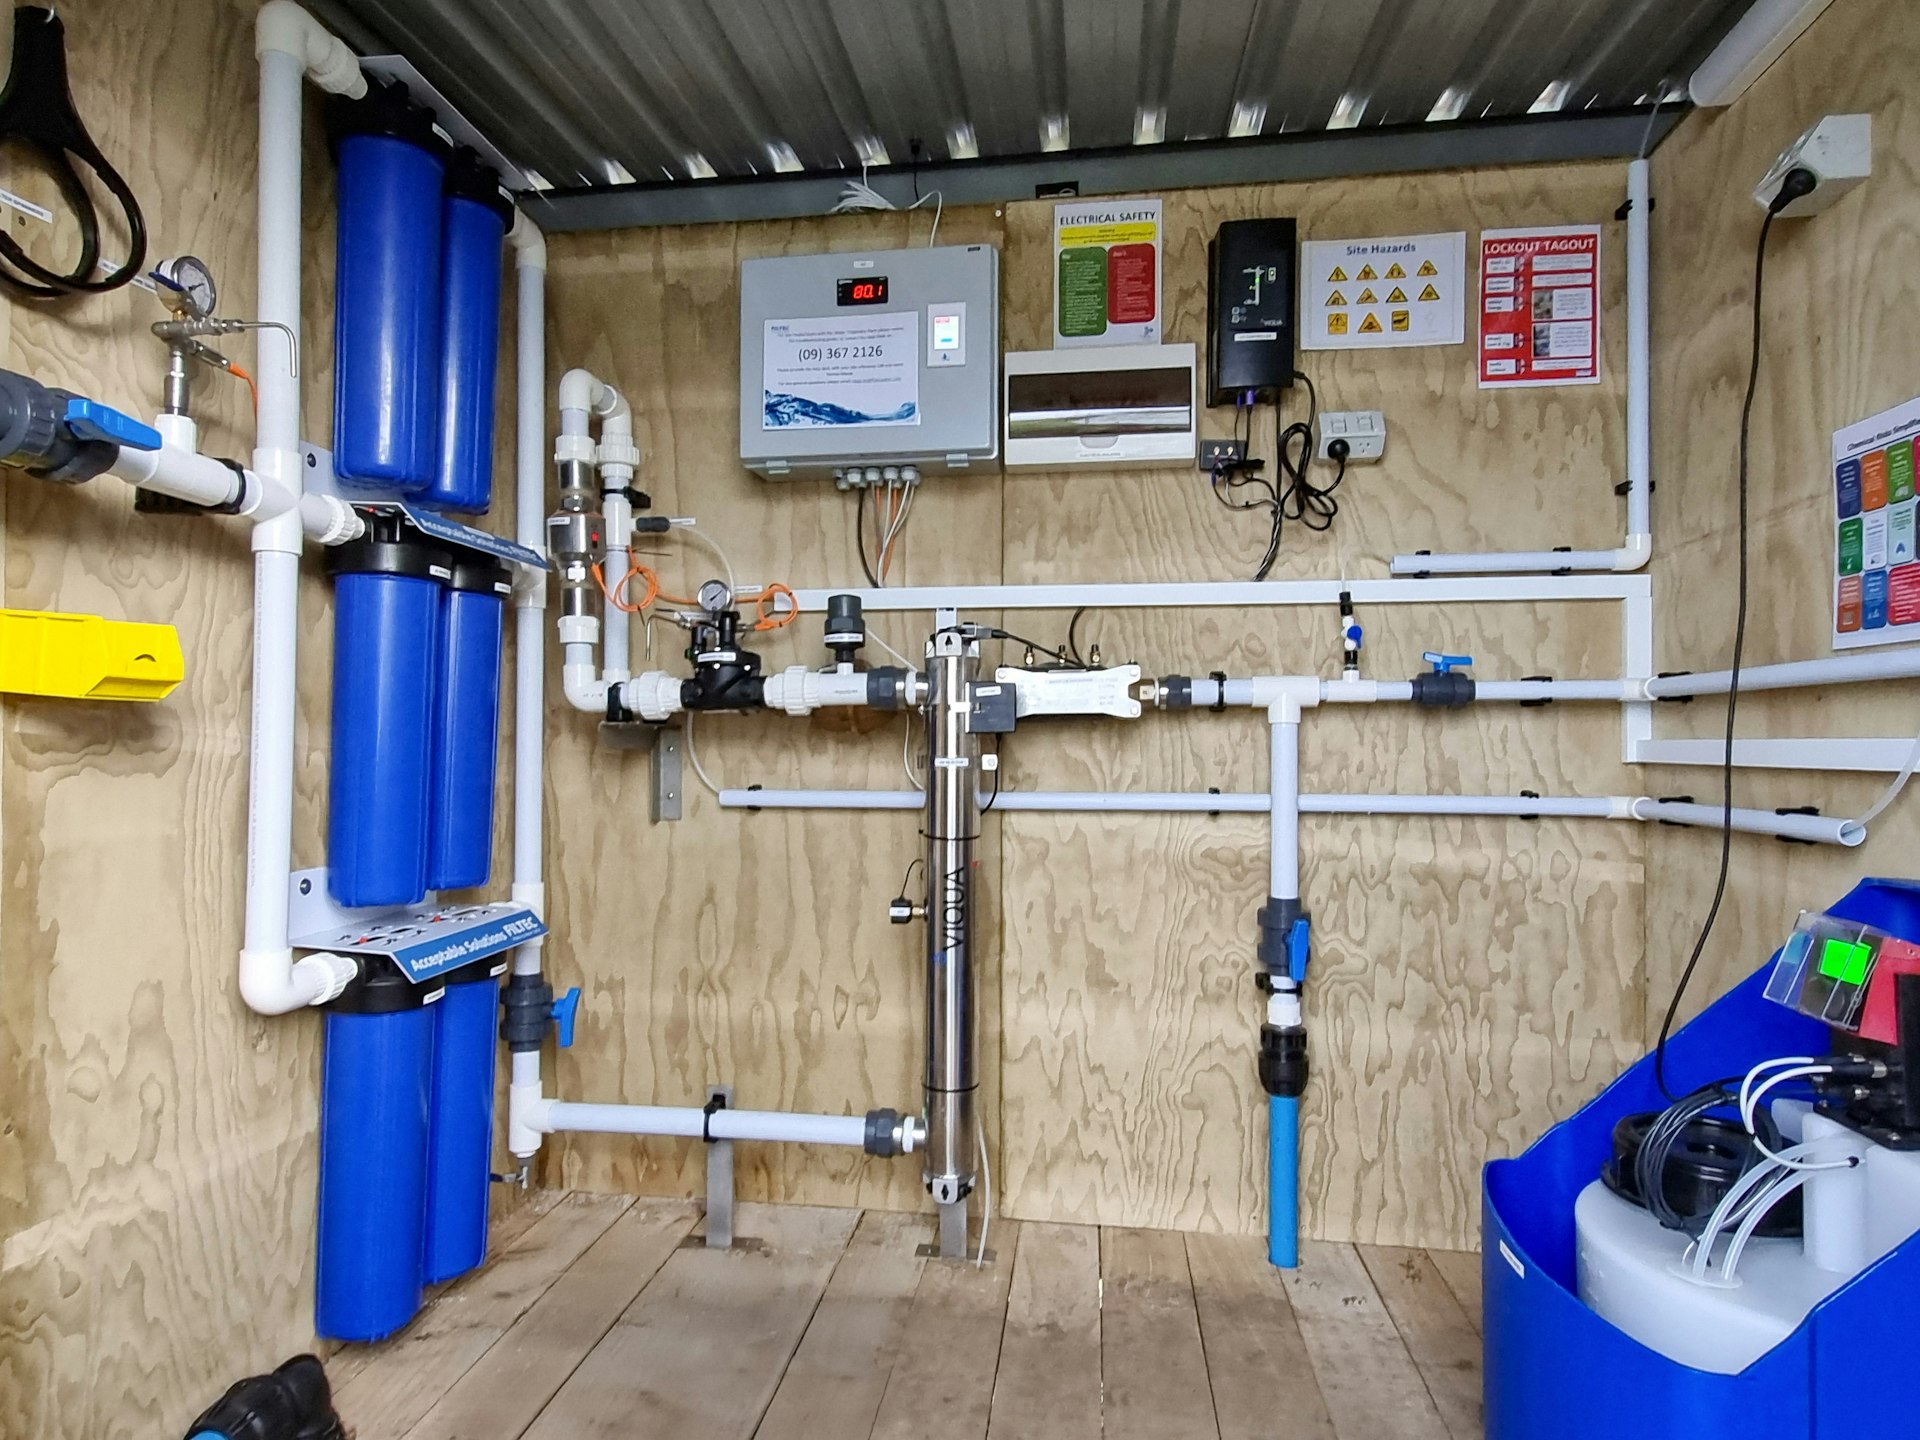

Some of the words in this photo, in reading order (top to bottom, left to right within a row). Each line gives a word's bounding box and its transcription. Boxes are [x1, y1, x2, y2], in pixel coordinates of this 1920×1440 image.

[1060, 213, 1116, 225] ELECTRICAL
[1119, 211, 1156, 221] SAFETY
[1346, 245, 1368, 256] Site
[1371, 242, 1416, 254] Hazards
[1484, 241, 1540, 254] LOCKOUT
[1543, 238, 1594, 251] TAGOUT
[798, 348, 823, 362] (09)
[826, 347, 849, 359] 367
[852, 345, 883, 358] 2126
[942, 867, 965, 952] VIQUA
[410, 943, 467, 972] Acceptable
[463, 930, 508, 953] Solutions
[502, 916, 539, 938] FILTEC
